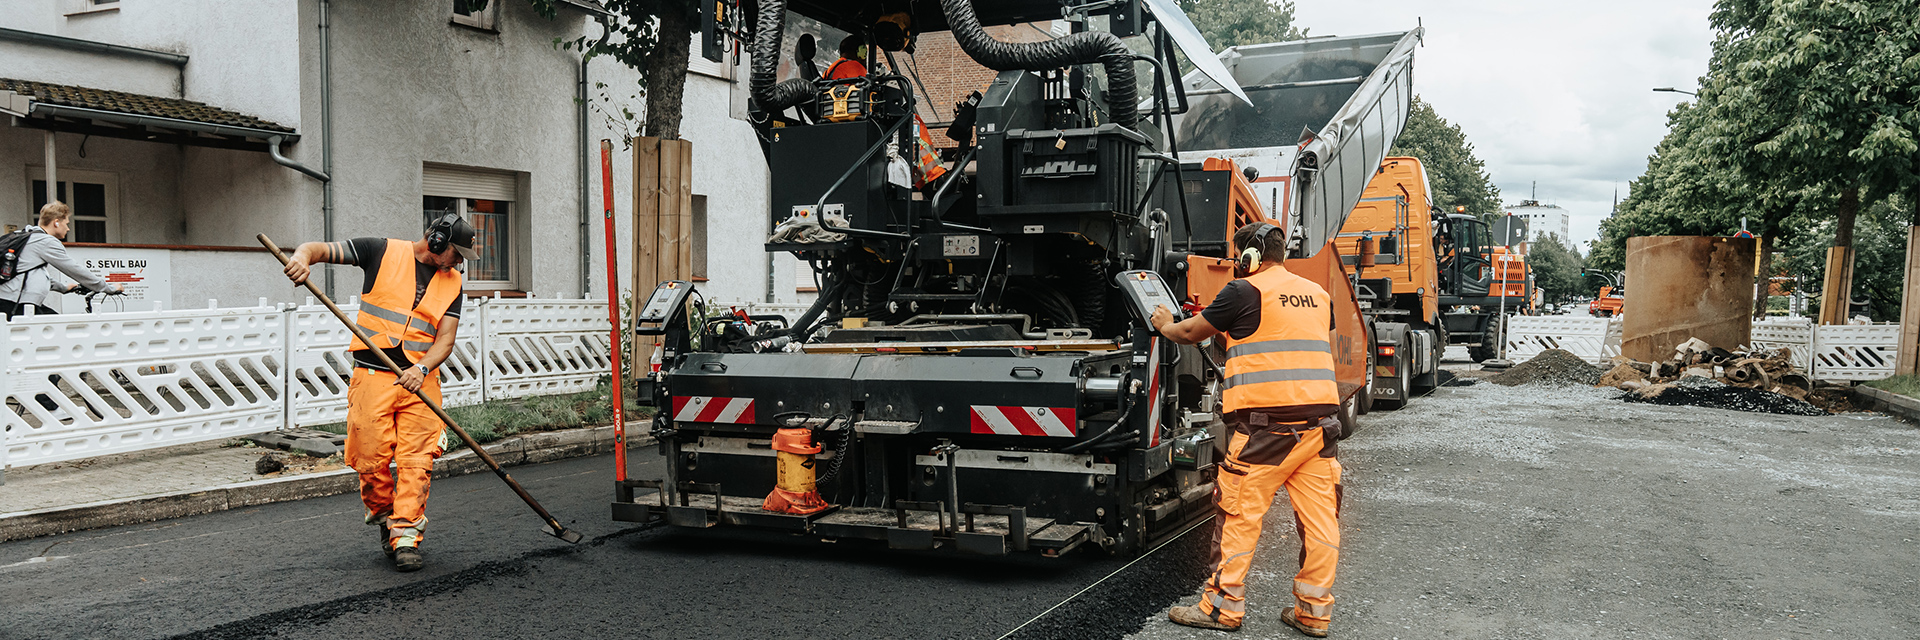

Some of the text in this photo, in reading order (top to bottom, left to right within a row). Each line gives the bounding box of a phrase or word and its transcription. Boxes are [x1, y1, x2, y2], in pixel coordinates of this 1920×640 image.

[86, 260, 147, 268] S. SEVIL BAU
[1279, 294, 1318, 307] POHL
